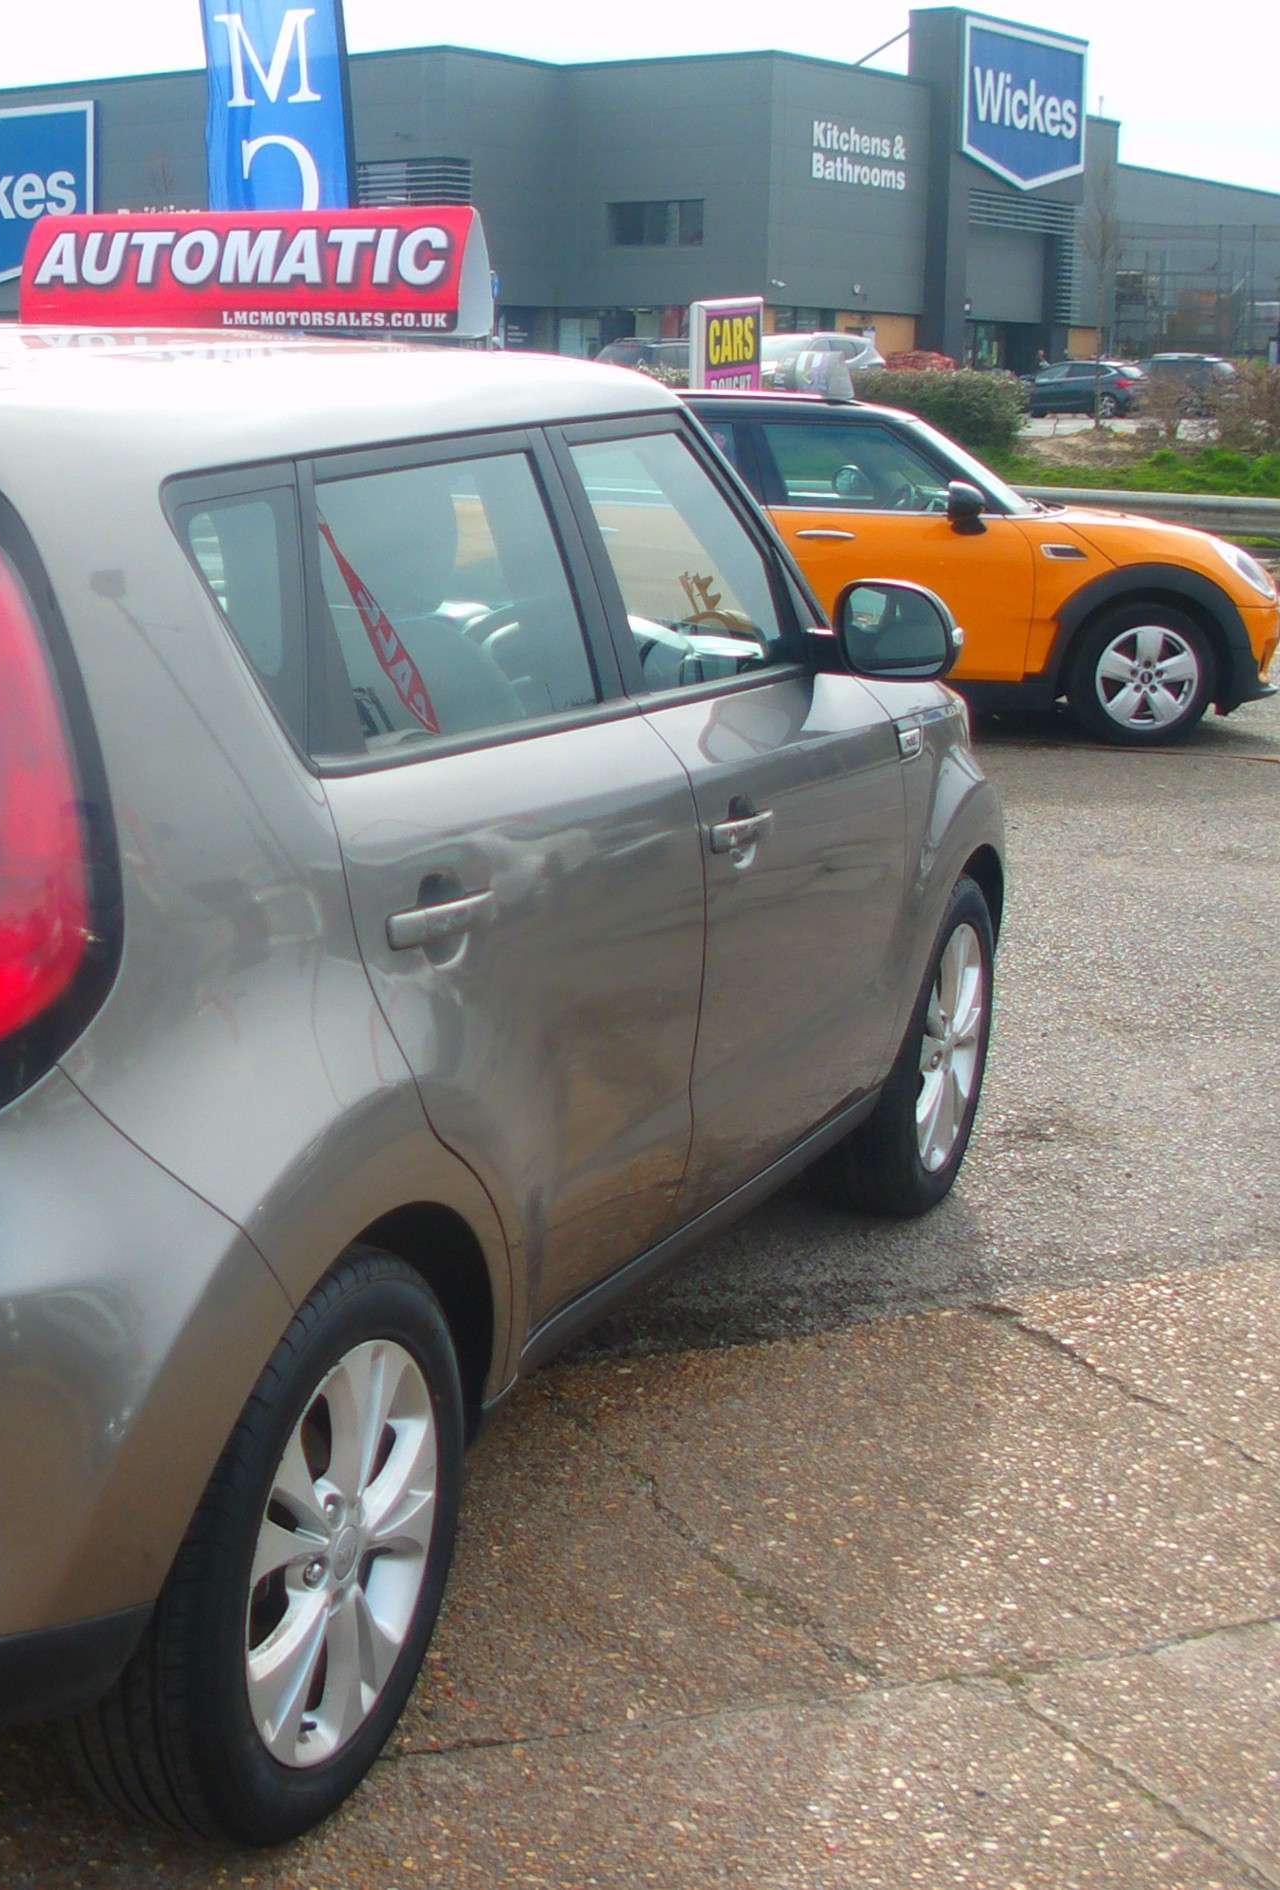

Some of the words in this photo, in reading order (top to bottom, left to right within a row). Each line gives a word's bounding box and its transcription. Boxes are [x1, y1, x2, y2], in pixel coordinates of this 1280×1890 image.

[973, 65, 1077, 140] Wickes
[813, 121, 890, 158] Kitchens
[893, 134, 906, 160] &
[812, 152, 906, 190] Bathrooms
[33, 228, 449, 286] AUTOMATIC
[222, 310, 448, 328] LMCMOTORSALES.CO.UK
[708, 315, 755, 365] CARS
